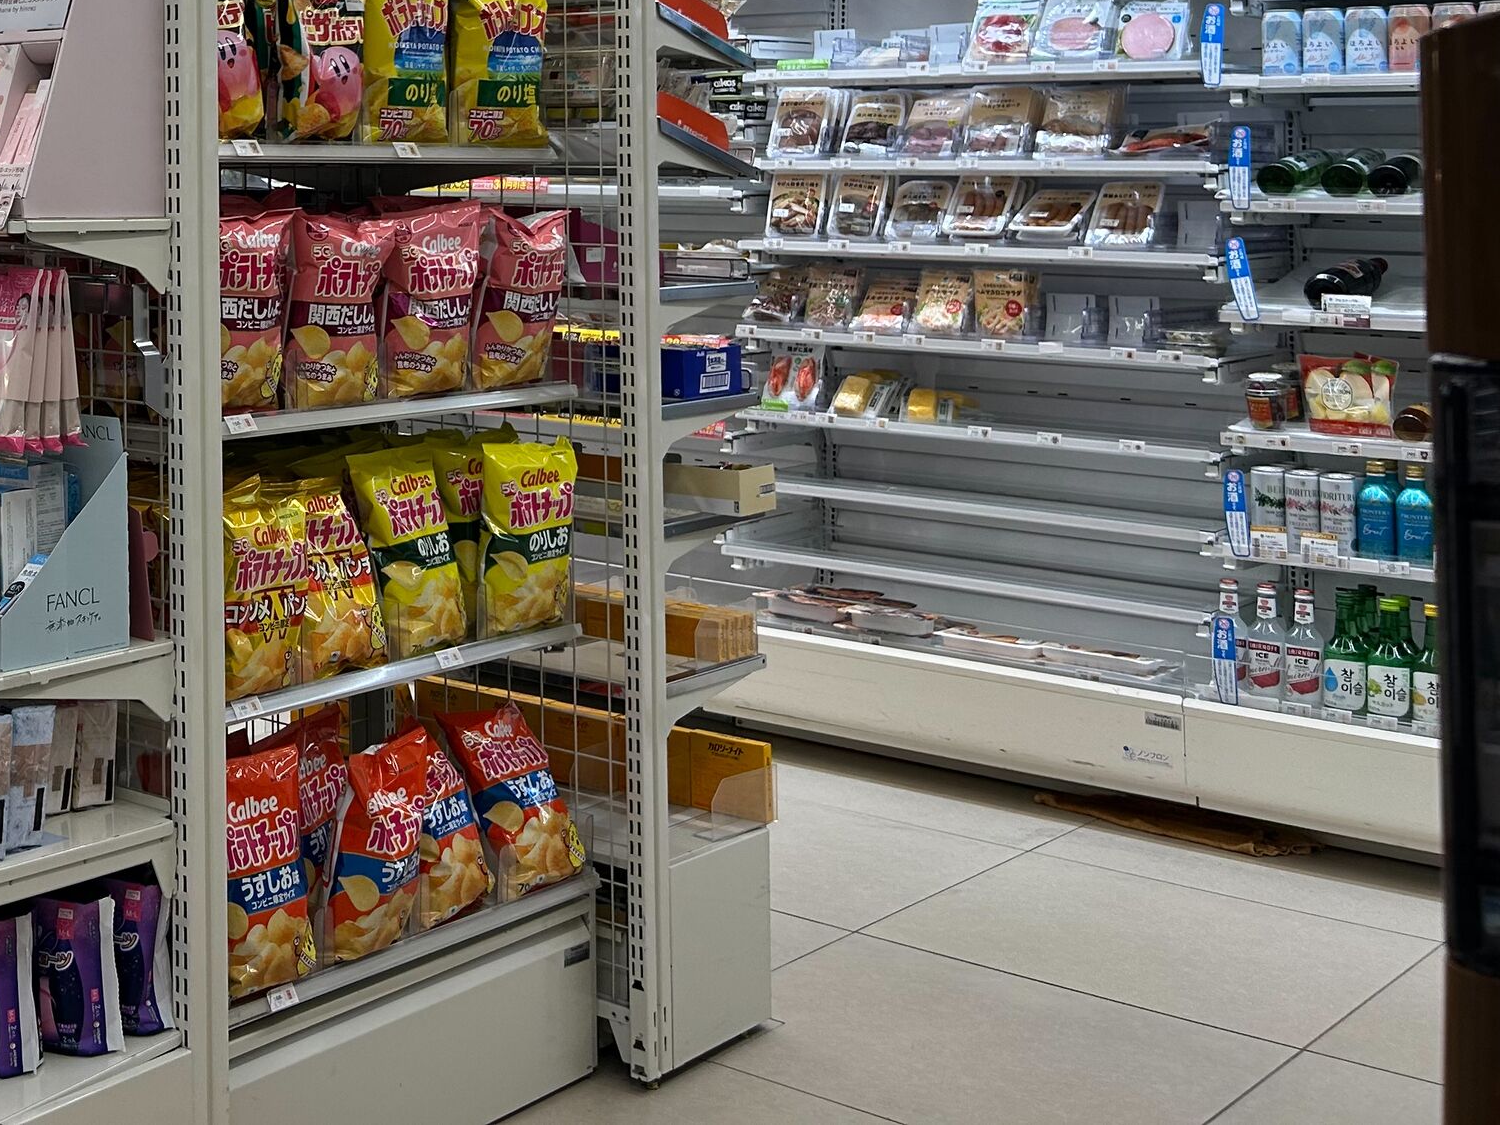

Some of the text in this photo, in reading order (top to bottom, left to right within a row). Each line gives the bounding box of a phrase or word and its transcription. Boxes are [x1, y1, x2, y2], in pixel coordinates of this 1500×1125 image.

[406, 83, 438, 104] のり塩
[497, 85, 536, 105] のり塩
[422, 234, 461, 255] Calbee
[390, 473, 432, 497] Calbee
[520, 469, 561, 489] Calbee
[253, 525, 289, 547] Calbee
[417, 533, 451, 556] のりしお
[528, 524, 569, 554] のりしお
[46, 587, 100, 612] FANCL
[226, 598, 271, 625] コンソメ
[1341, 668, 1364, 696] 참이슬
[1383, 674, 1407, 702] 참이슬
[1137, 750, 1170, 761] ノンフロン
[228, 794, 279, 823] Calbee
[240, 867, 300, 902] うすしお味
[251, 888, 296, 910] コンビニ限定サイズ
